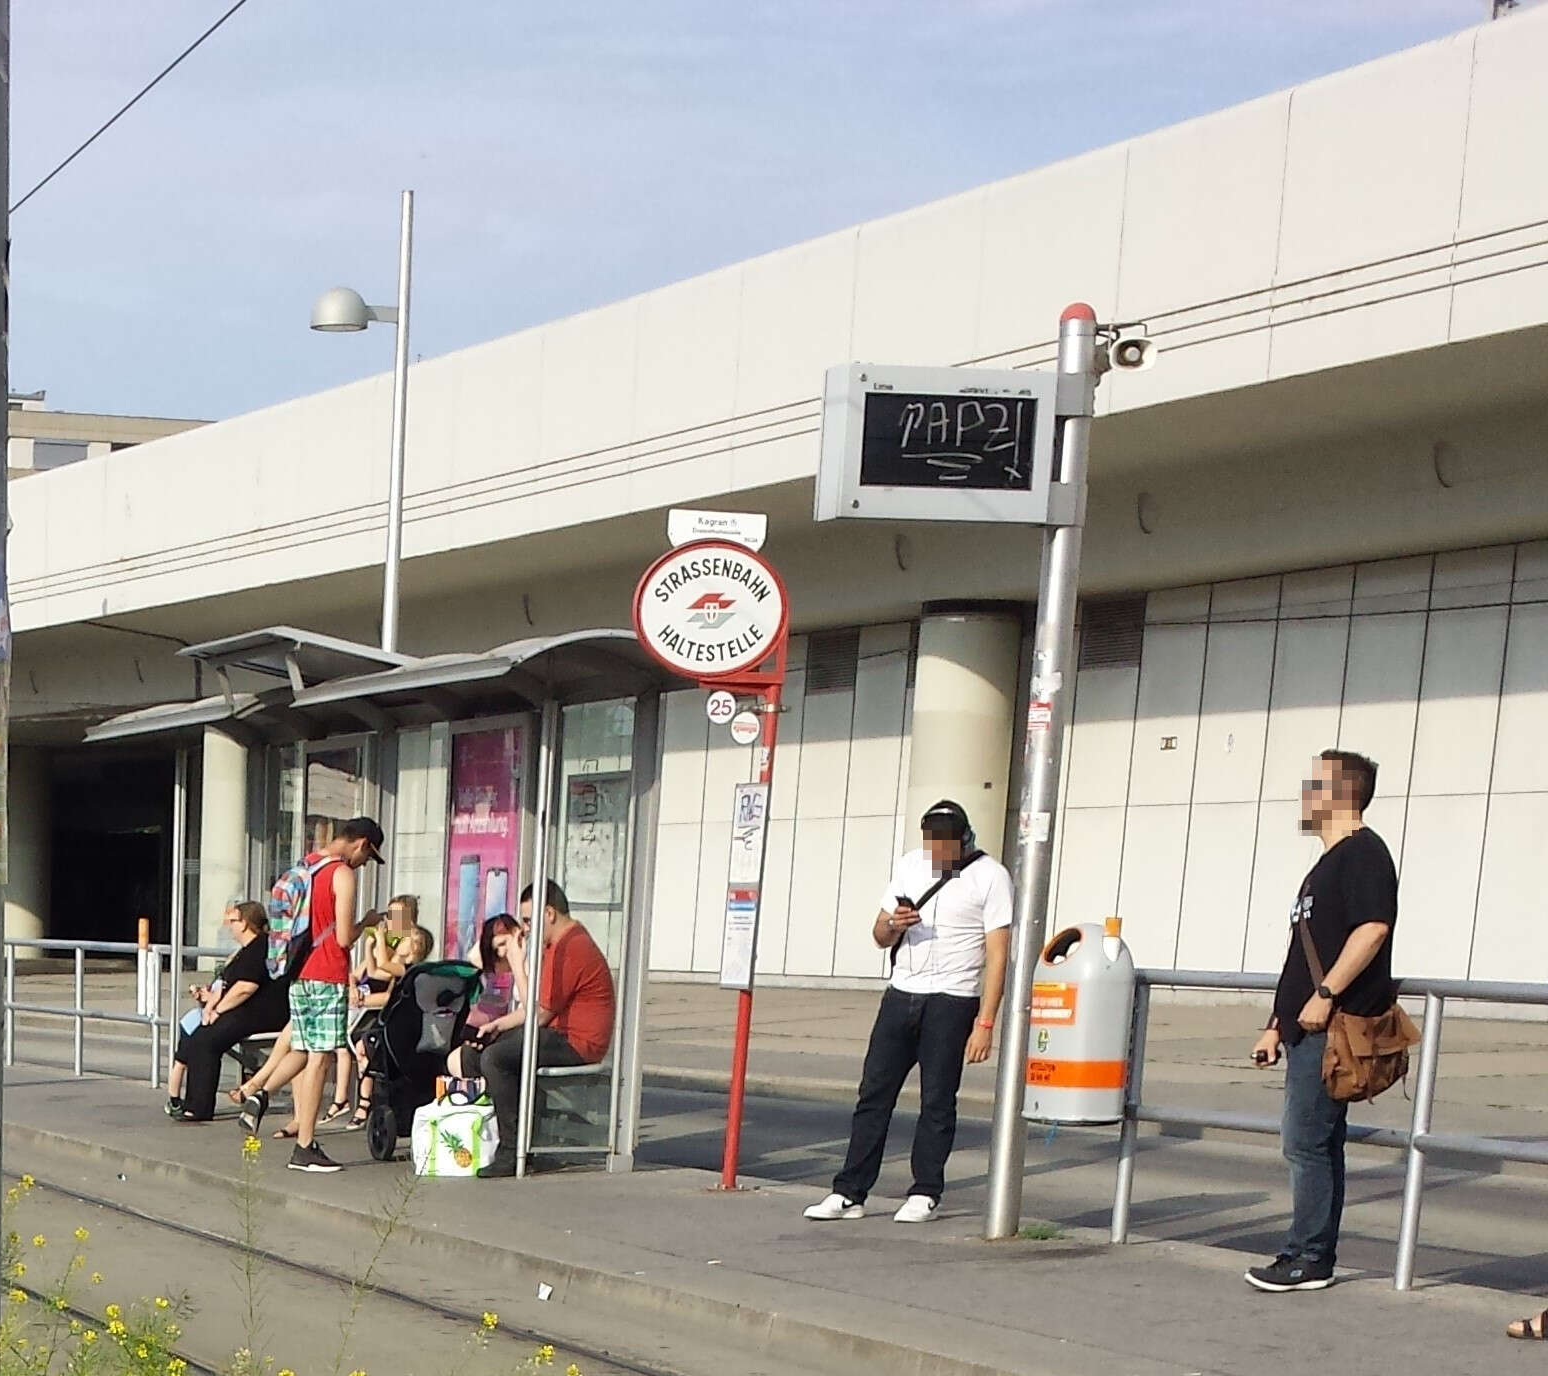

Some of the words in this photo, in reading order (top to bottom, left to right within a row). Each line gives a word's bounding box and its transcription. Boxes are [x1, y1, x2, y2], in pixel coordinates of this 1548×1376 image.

[698, 517, 728, 527] Kagran
[655, 558, 771, 603] STRASSENBAHN
[658, 624, 764, 662] HALTESTELLE
[710, 699, 733, 716] 25
